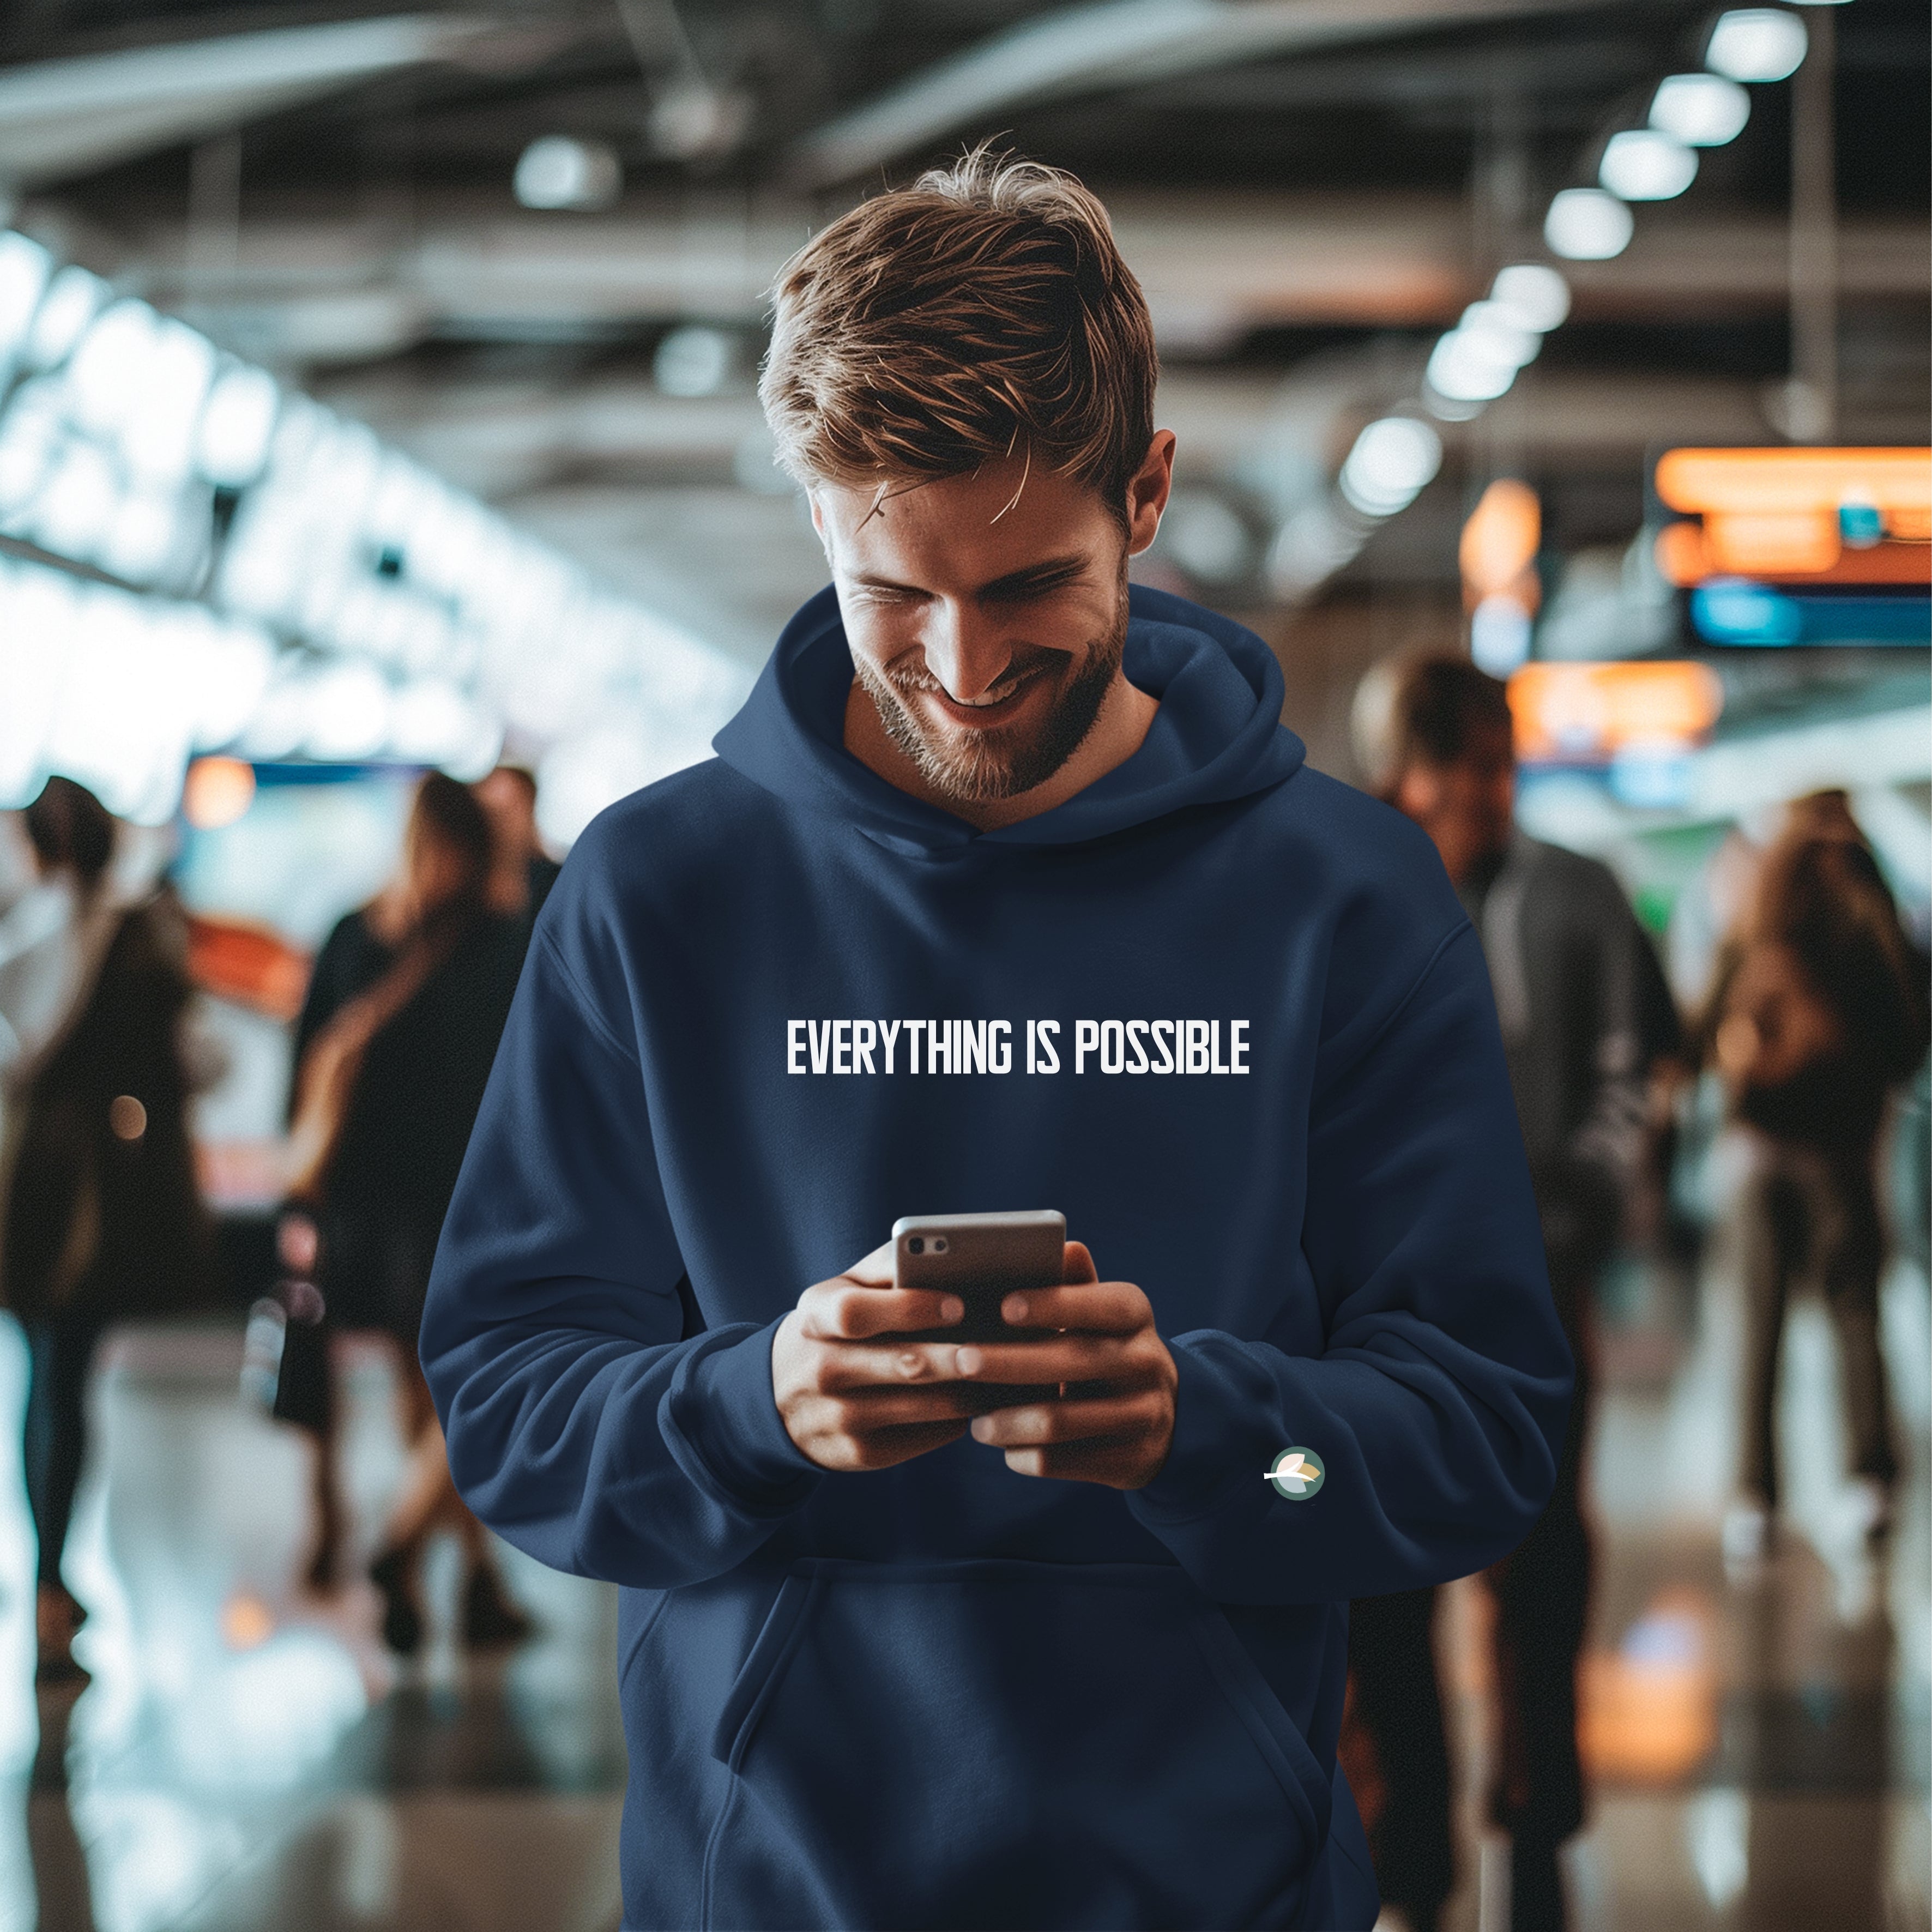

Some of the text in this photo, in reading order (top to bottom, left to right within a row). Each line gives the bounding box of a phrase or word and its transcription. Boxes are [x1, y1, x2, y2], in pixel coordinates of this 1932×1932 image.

[787, 1020, 1249, 1074] EVERYTHING IS POSSIBLE
